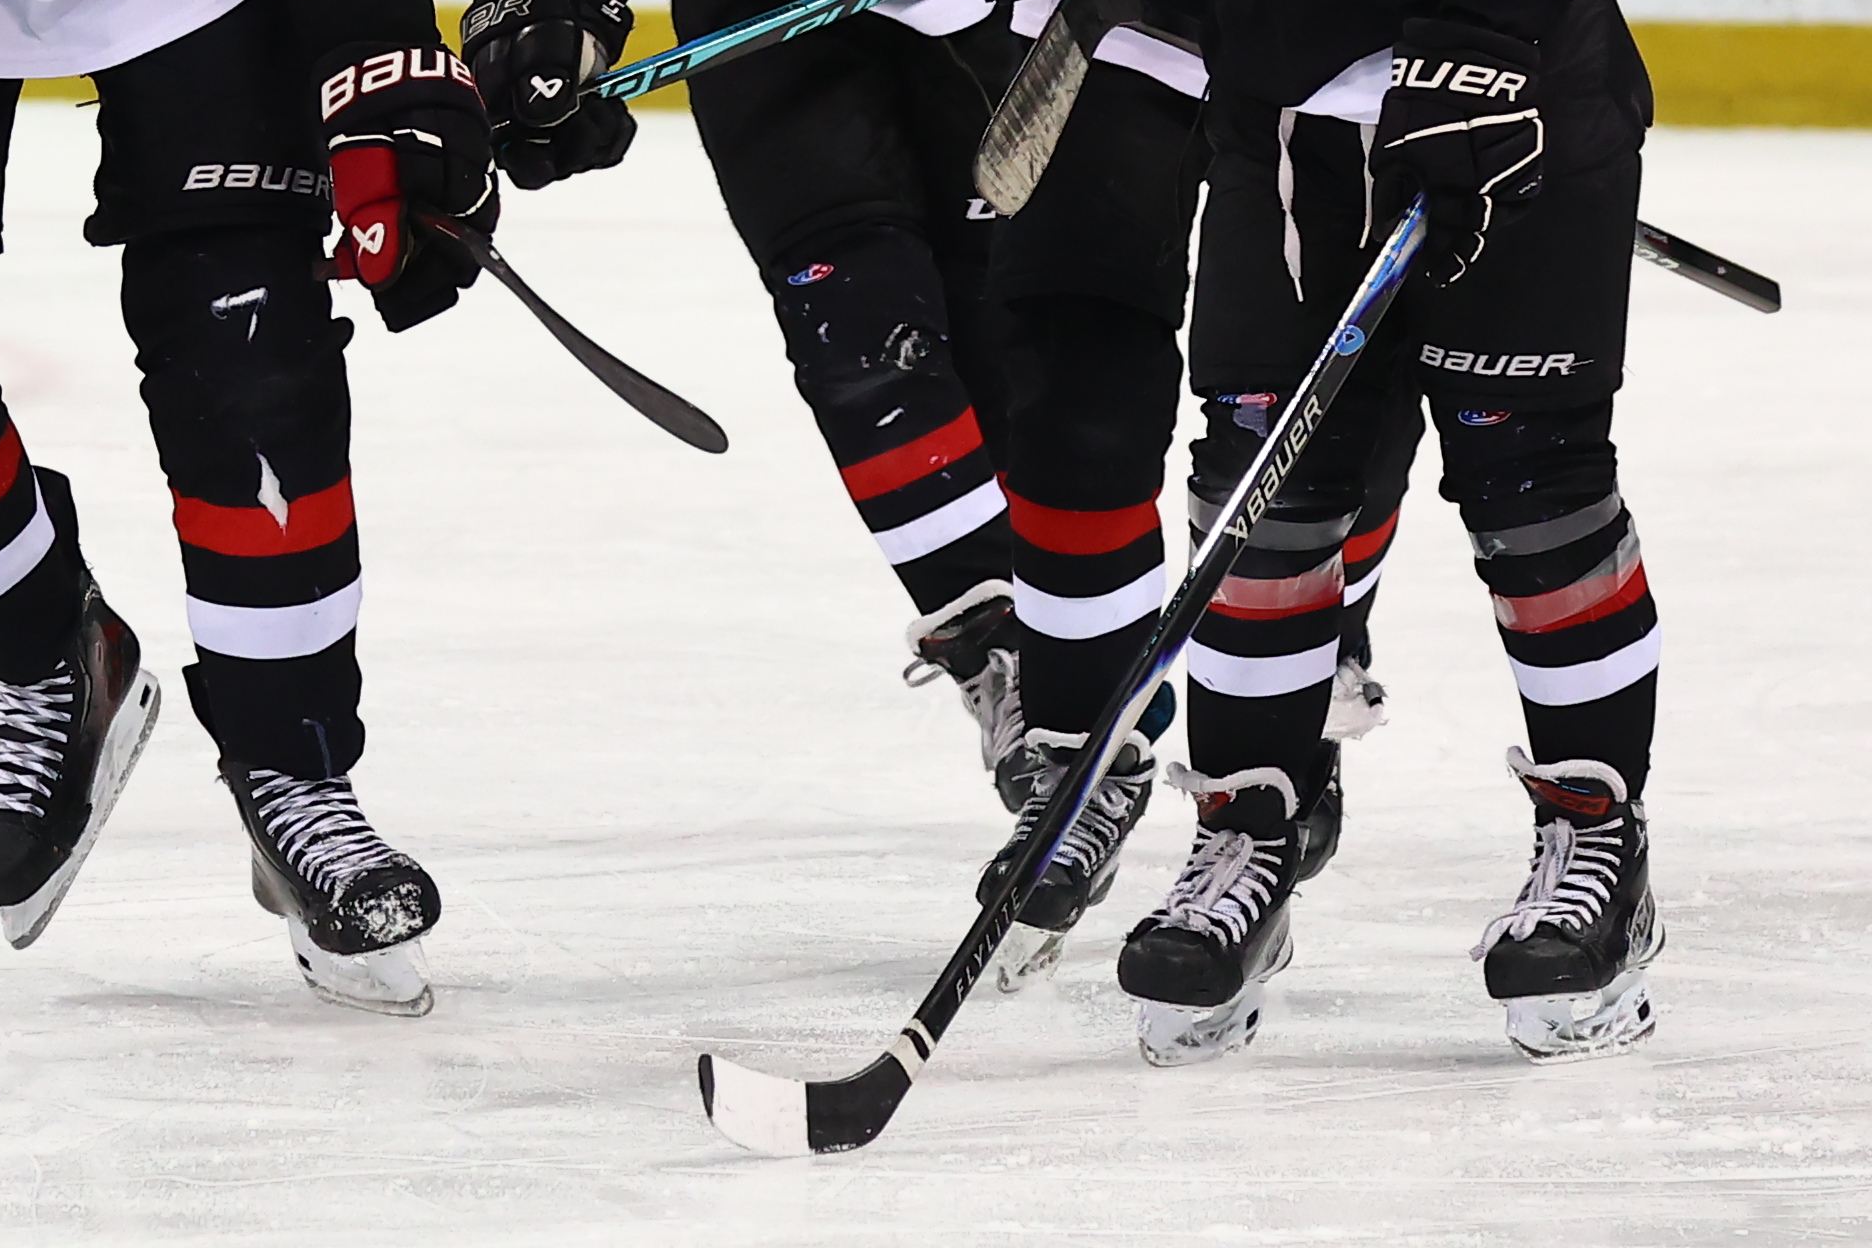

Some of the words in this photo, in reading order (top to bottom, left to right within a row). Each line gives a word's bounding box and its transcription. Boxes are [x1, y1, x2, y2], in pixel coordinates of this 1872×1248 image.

[321, 48, 476, 124] BAUE
[1391, 57, 1528, 102] AUER
[1420, 344, 1577, 378] BAUER
[1245, 392, 1324, 527] BAUER
[954, 886, 1022, 1003] FLYLITE
